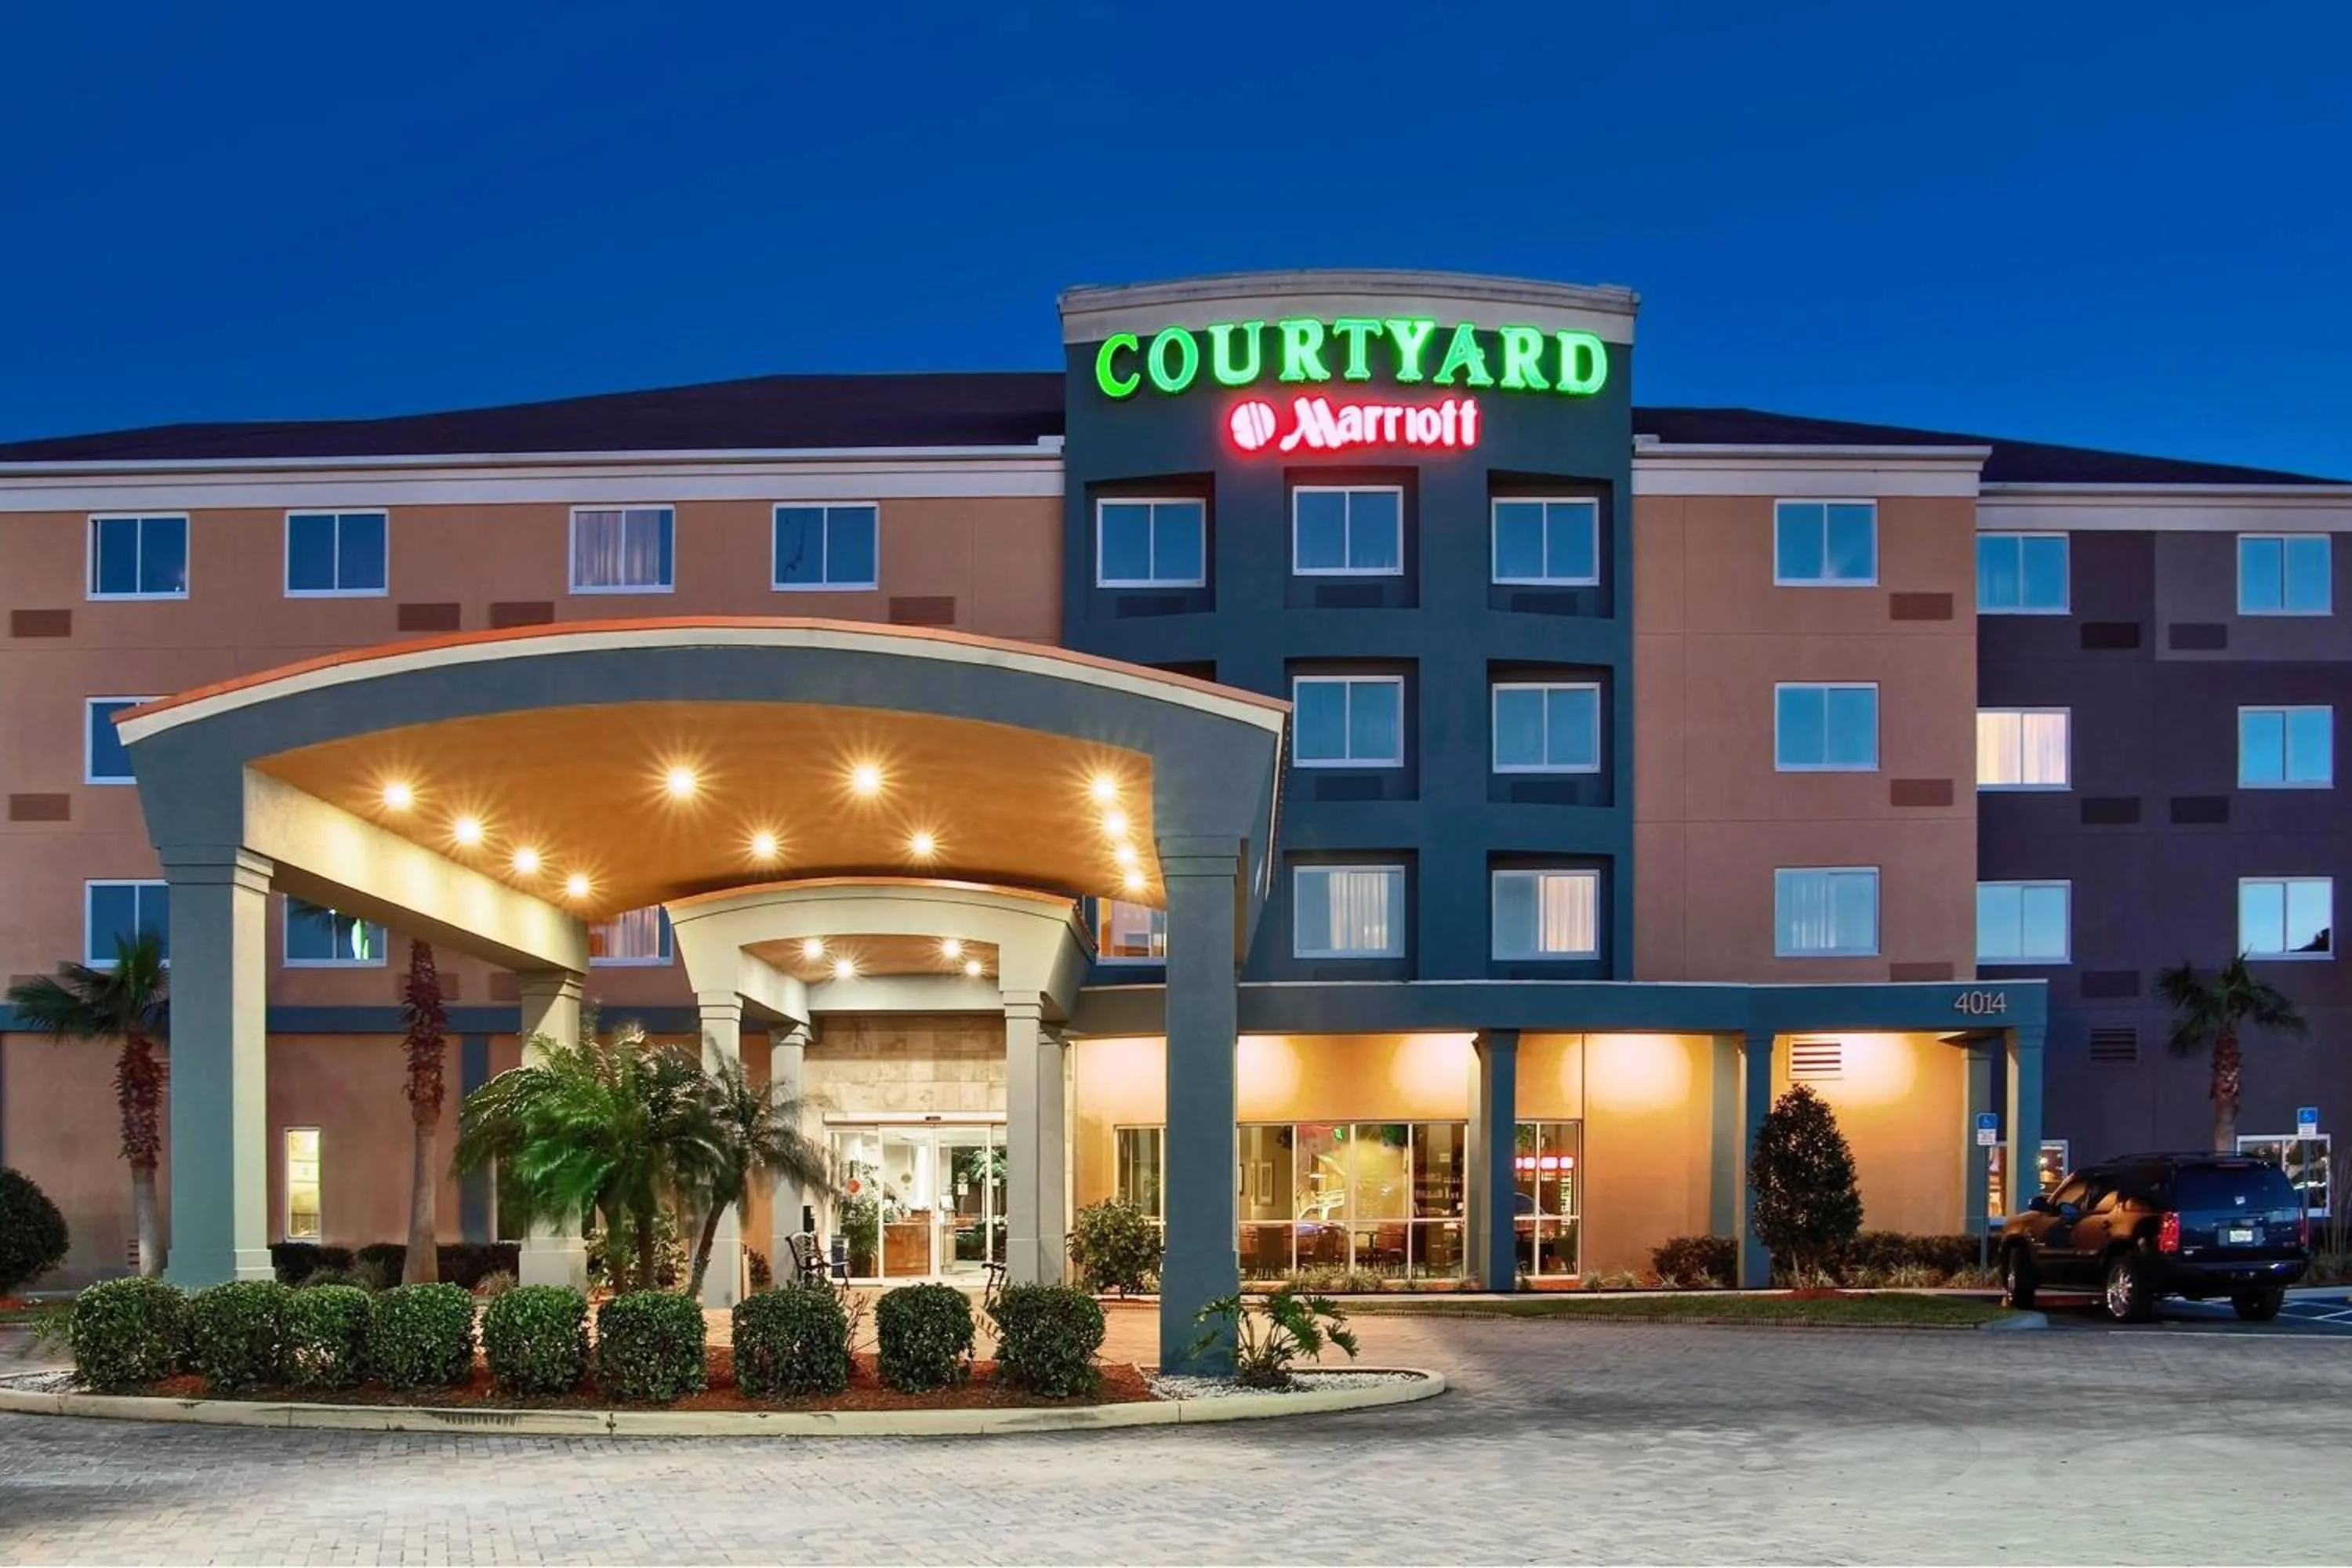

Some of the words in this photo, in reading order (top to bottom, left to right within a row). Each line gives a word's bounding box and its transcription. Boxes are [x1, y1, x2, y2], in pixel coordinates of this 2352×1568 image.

[1095, 318, 1609, 397] COURTYARD
[1279, 397, 1477, 452] Marriott
[1955, 992, 2007, 1014] 4014
